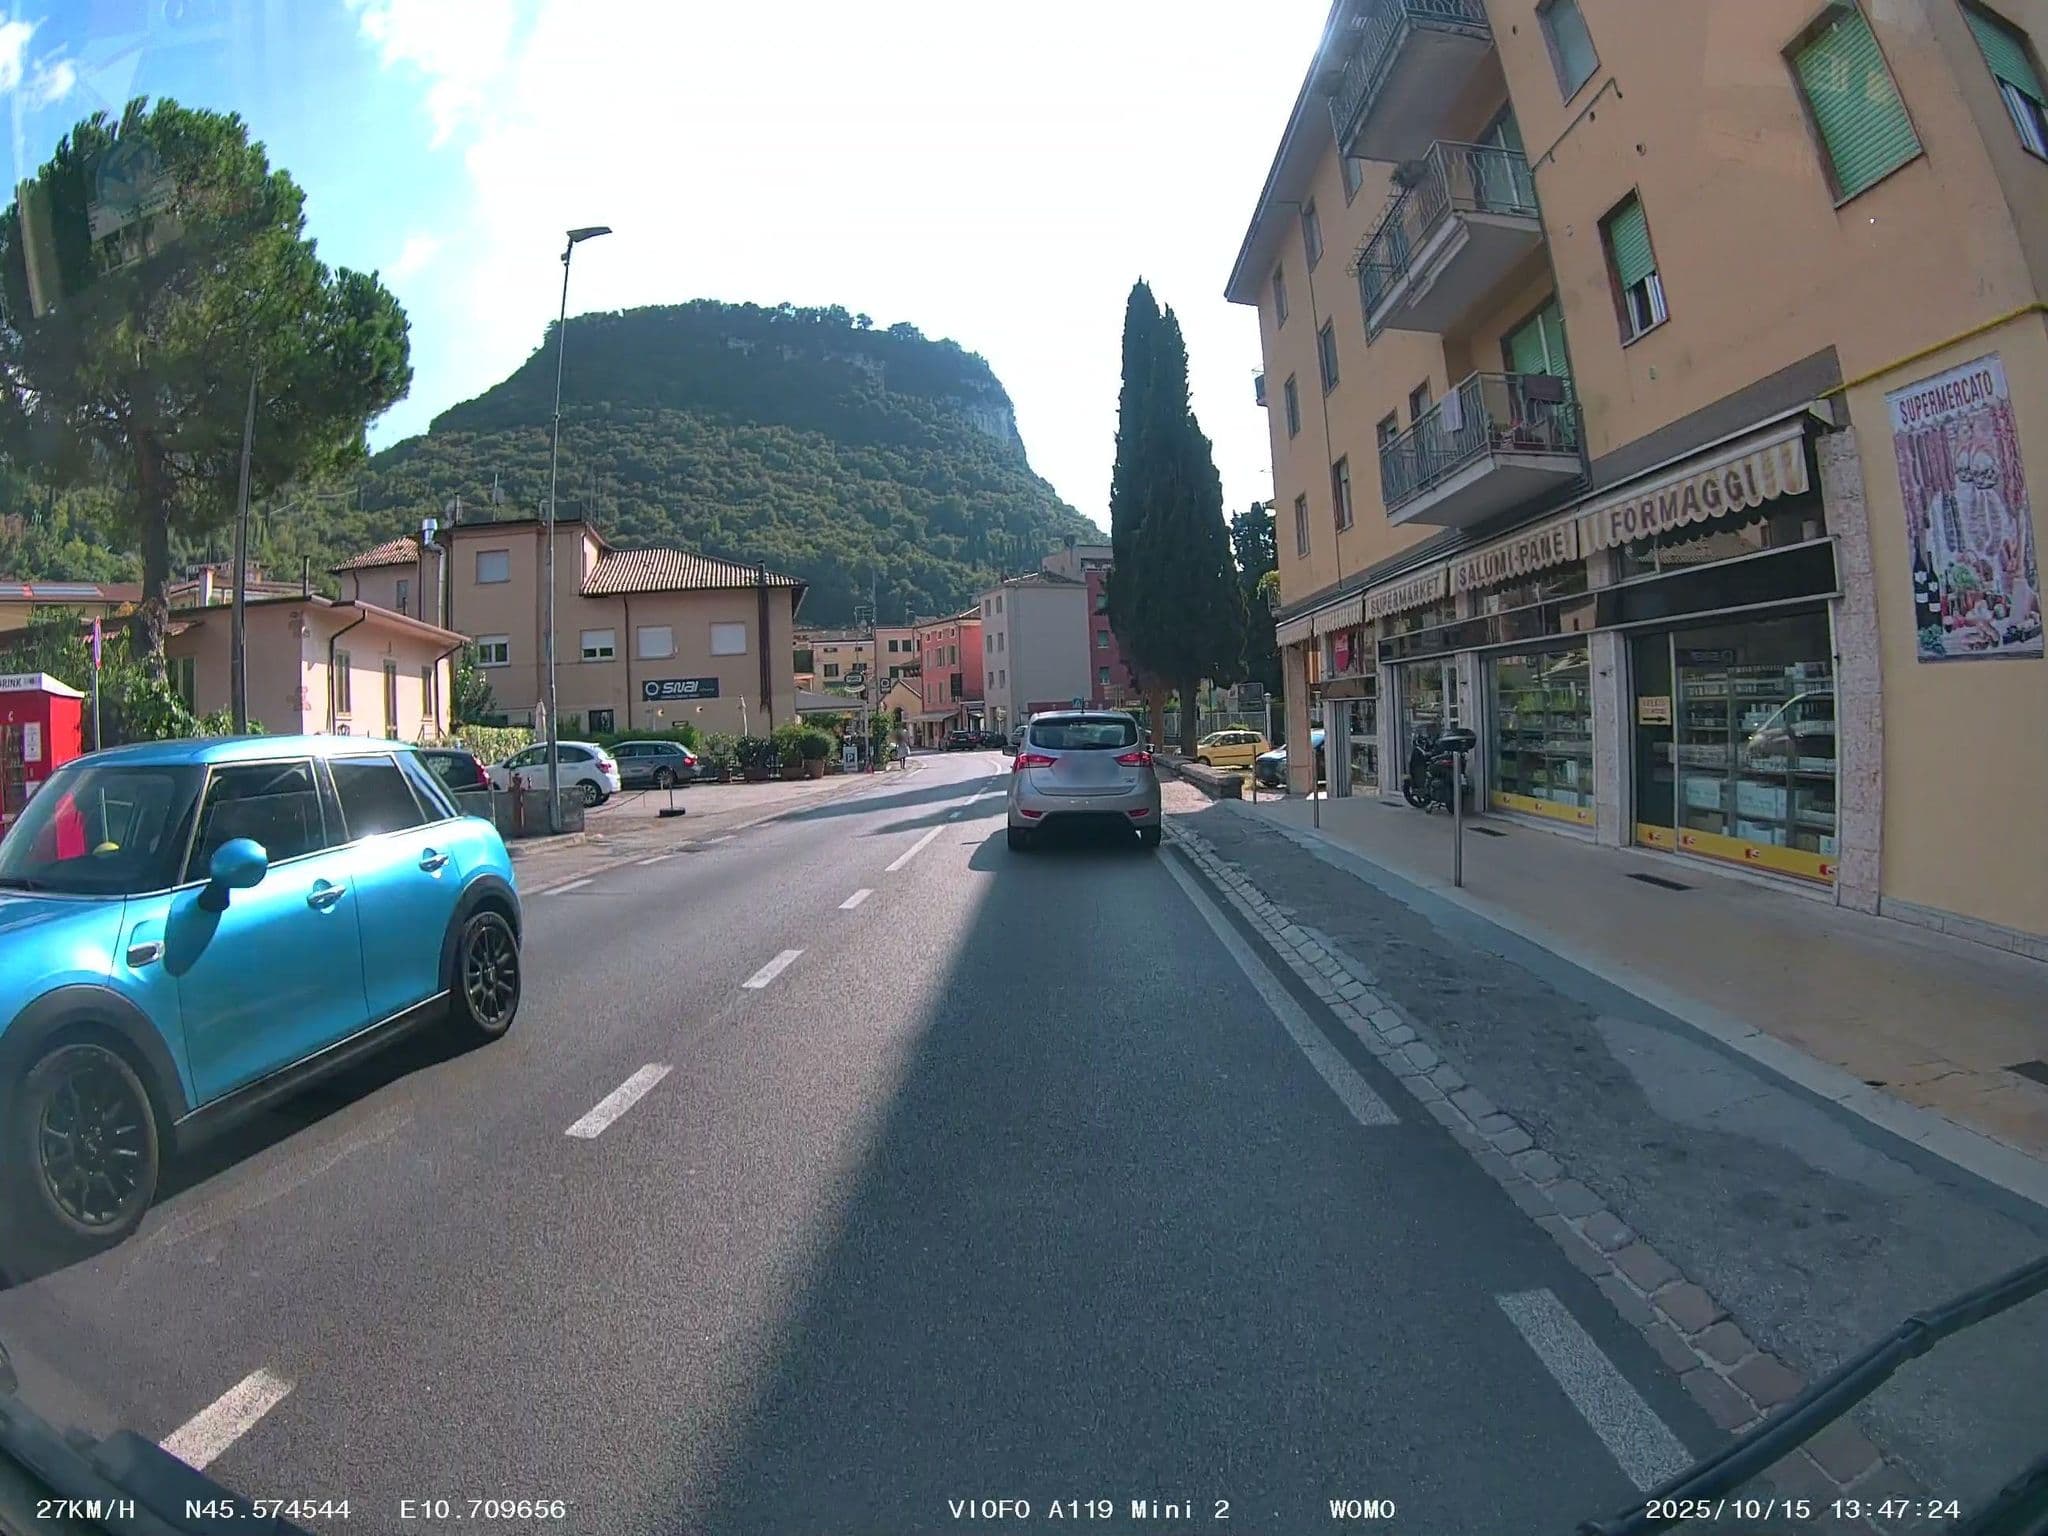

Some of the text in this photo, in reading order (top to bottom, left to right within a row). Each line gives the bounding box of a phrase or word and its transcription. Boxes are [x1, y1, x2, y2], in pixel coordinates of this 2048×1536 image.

[1900, 369, 1993, 424] SUPERMERCATO
[1611, 464, 1758, 538] FORMAGGI
[1370, 576, 1440, 615] SUPERMARKET
[0, 678, 21, 688] RINK
